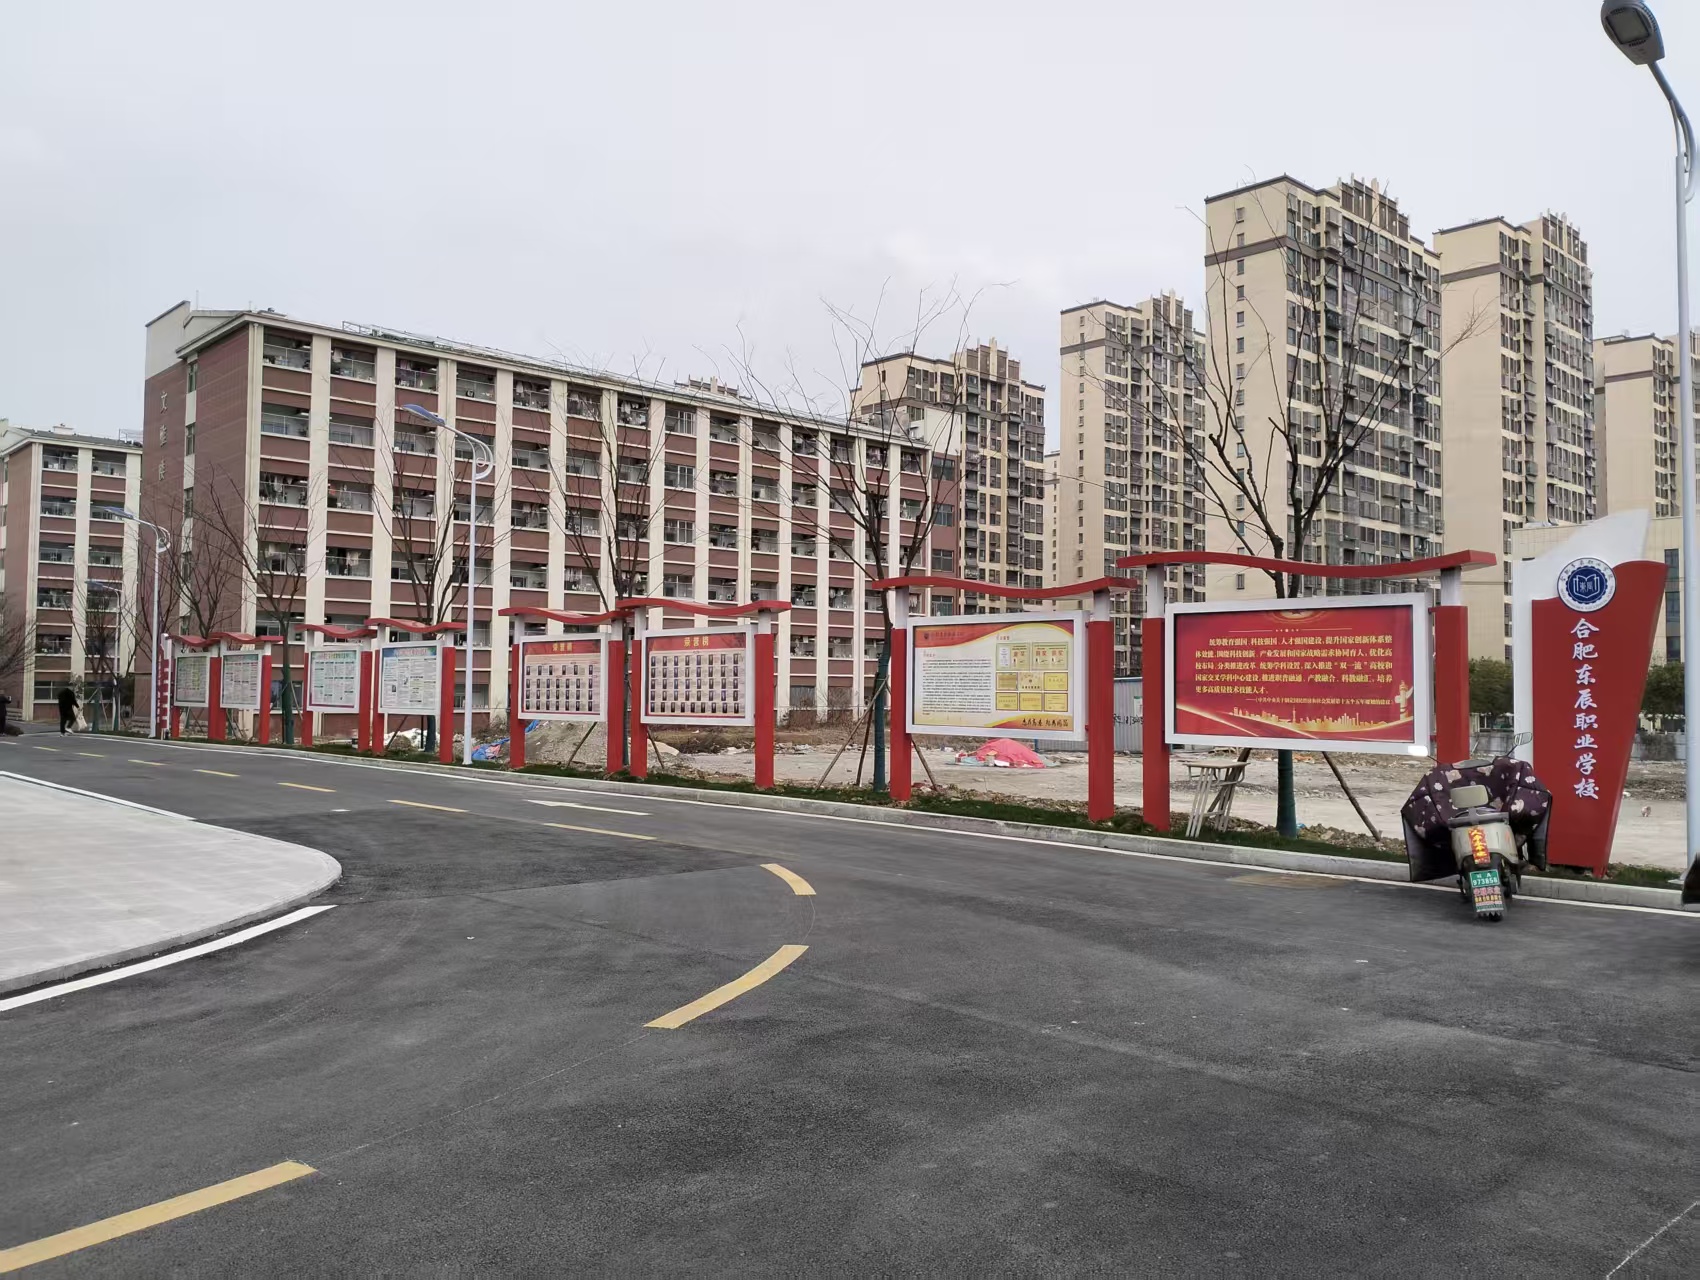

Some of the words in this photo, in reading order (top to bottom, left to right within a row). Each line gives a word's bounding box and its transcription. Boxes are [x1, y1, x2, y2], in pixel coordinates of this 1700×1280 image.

[684, 636, 709, 647] 荣誉榜
[1570, 617, 1600, 800] 合肥东辰职业学校
